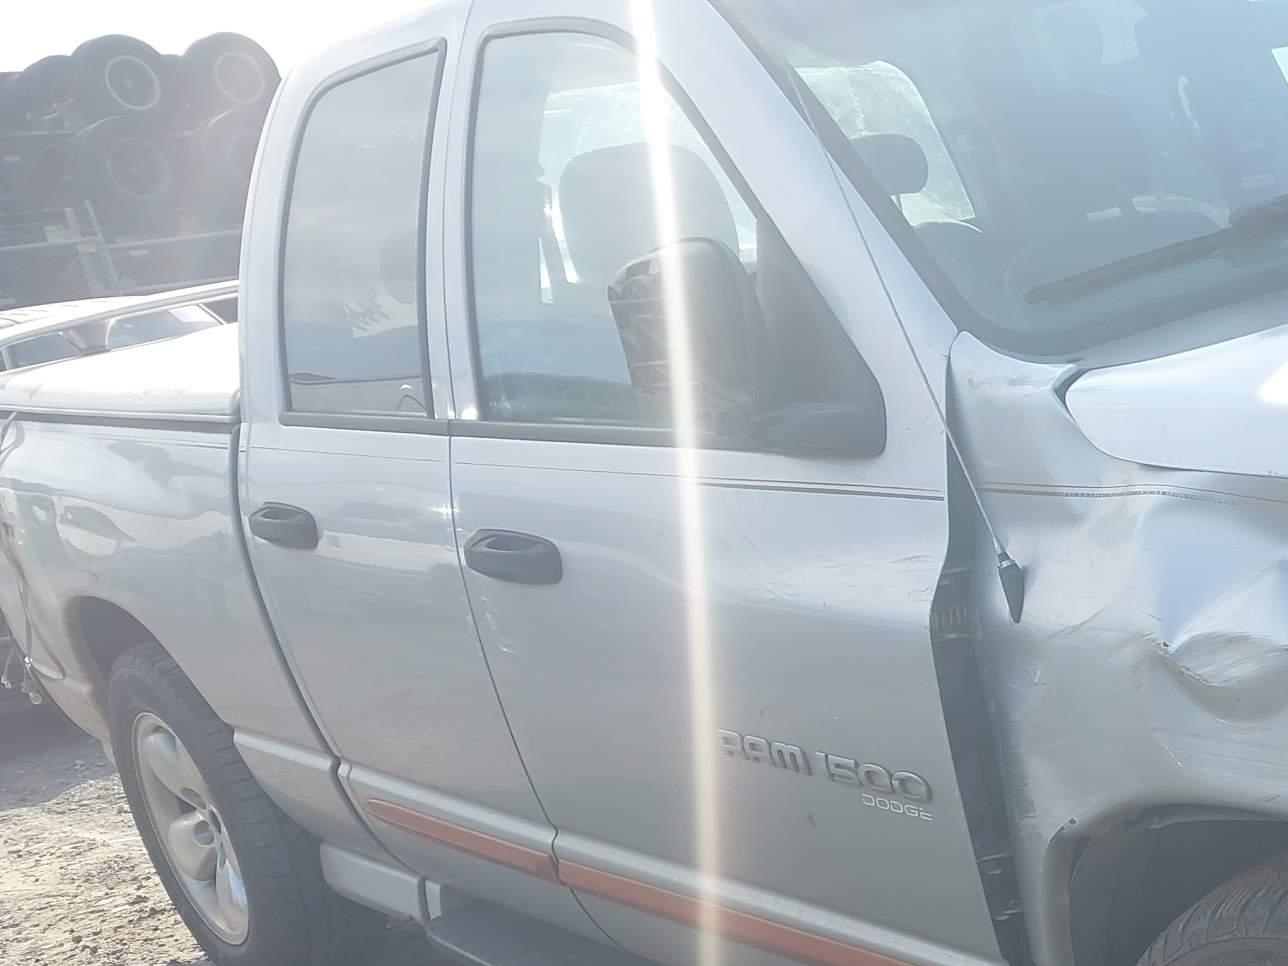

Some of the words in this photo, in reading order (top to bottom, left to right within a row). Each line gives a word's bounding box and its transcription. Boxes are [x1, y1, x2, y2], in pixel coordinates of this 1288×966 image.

[718, 728, 812, 777] RAM
[815, 750, 932, 801] 1500
[861, 793, 933, 821] DODGE
